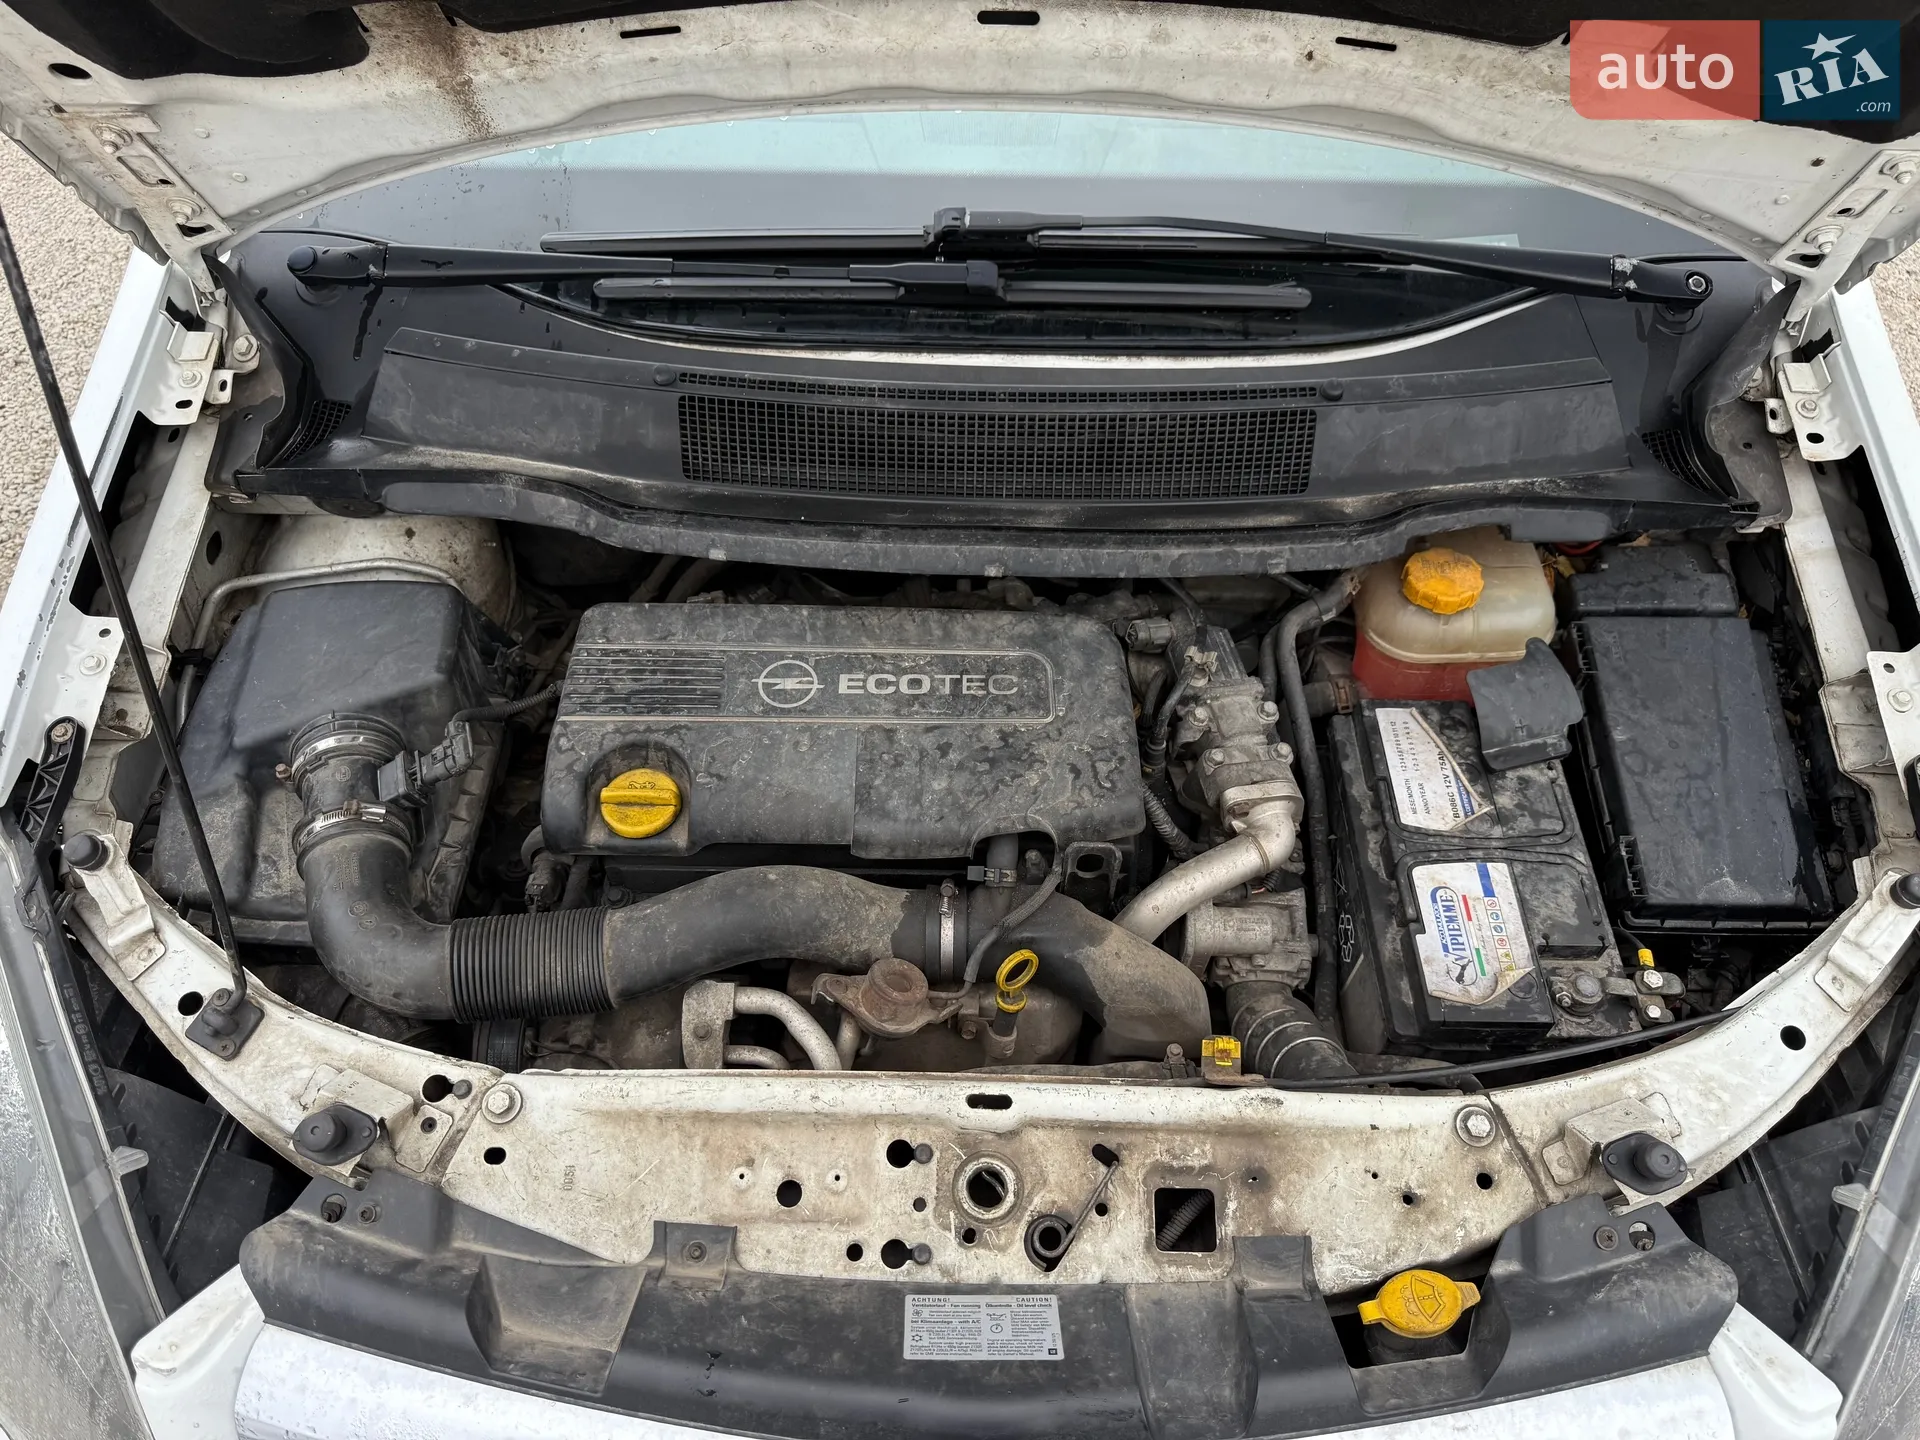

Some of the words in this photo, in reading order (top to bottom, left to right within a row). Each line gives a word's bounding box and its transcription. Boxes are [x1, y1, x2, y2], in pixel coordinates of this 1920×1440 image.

[837, 673, 1019, 695] ECOTEC
[1442, 773, 1452, 788] 12V
[1404, 778, 1417, 815] MESE/MONTH
[1418, 783, 1431, 815] ANNO/YEAR
[1447, 792, 1460, 819] B086C
[1440, 895, 1468, 961] VIPIEMME
